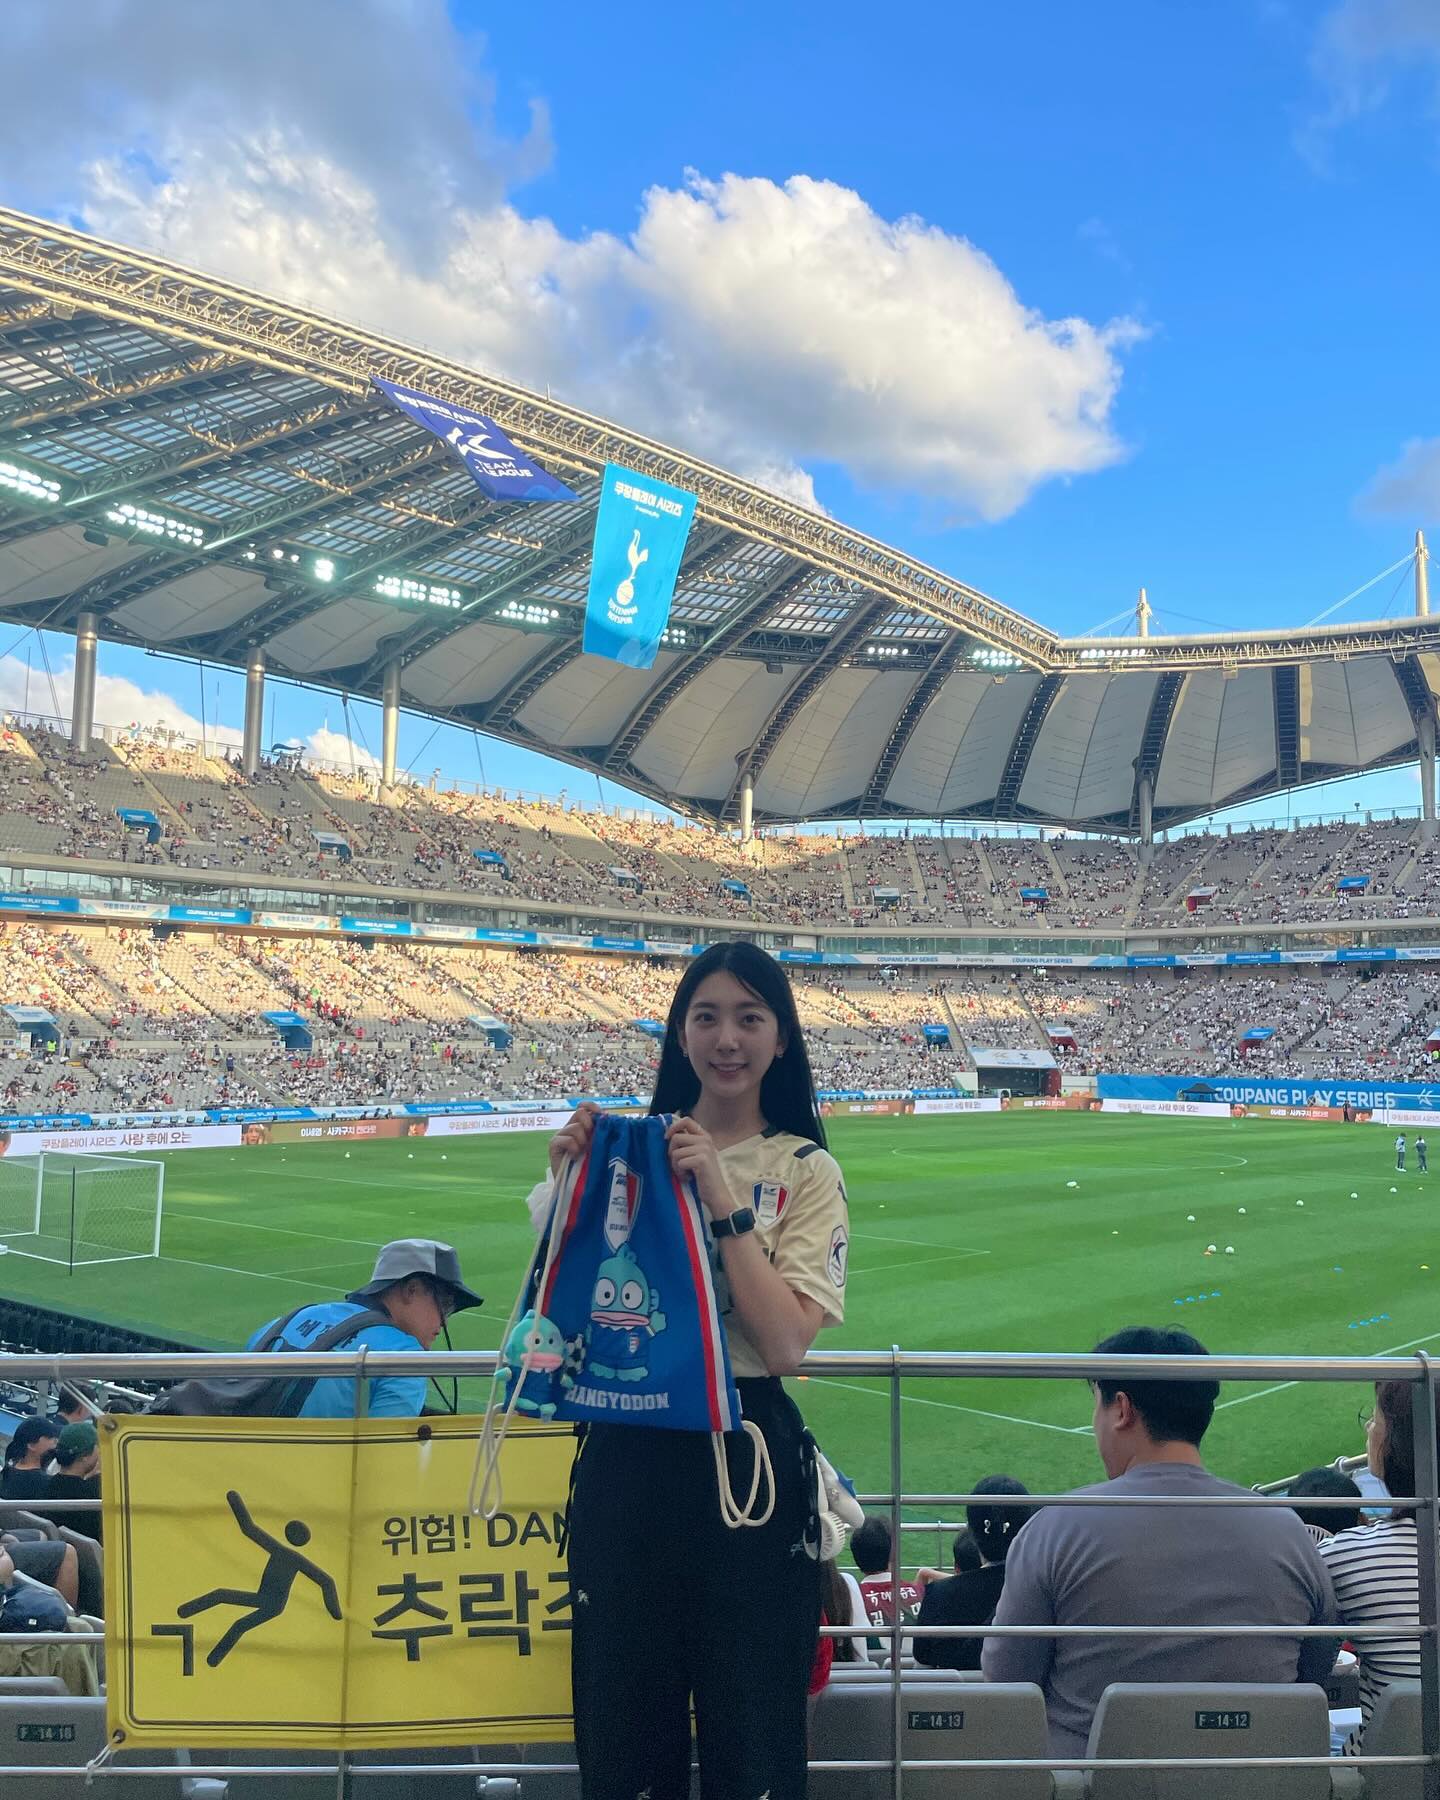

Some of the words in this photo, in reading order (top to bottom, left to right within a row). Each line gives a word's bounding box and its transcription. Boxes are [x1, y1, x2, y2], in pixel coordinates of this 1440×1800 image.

[1214, 1086, 1288, 1104] COUPANG
[1292, 1090, 1334, 1107] PLAY
[1335, 1091, 1396, 1108] SERIES
[502, 1117, 518, 1128] 사랑
[519, 1117, 535, 1127] 후에
[536, 1116, 551, 1126] 오는
[41, 1138, 88, 1149] 쿠팡플레이
[89, 1136, 117, 1147] 시리즈
[120, 1133, 144, 1146] 사랑
[146, 1132, 168, 1145] 후에
[170, 1131, 193, 1144] 오는
[381, 1513, 471, 1556] 위험!
